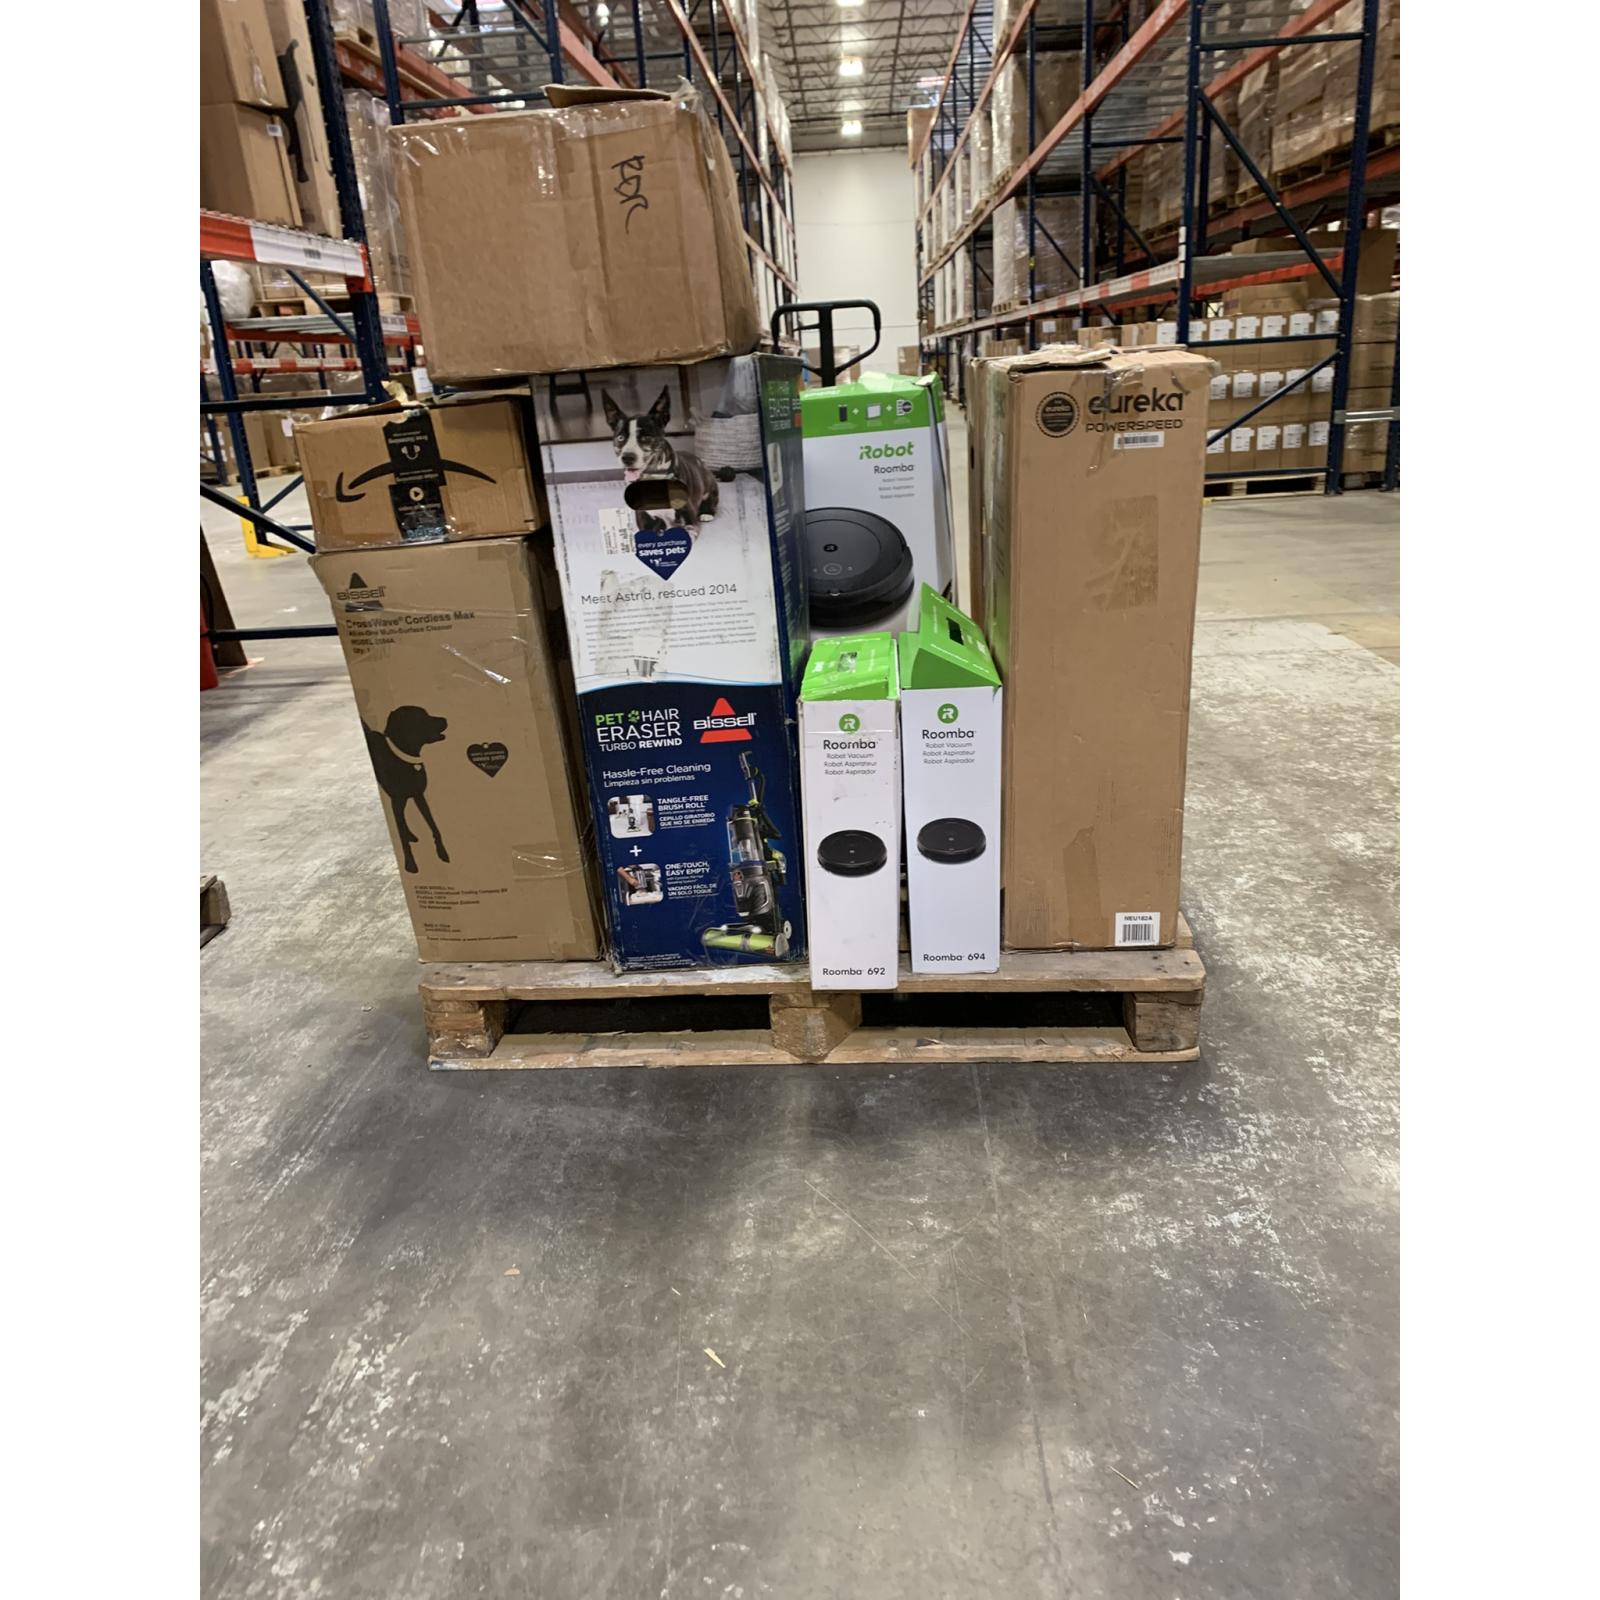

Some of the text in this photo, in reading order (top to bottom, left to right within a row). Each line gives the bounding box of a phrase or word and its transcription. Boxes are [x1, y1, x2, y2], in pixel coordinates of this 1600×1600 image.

[1088, 388, 1184, 414] eureka
[1086, 419, 1184, 432] POWERSPEED
[859, 442, 914, 460] iRobot
[874, 464, 914, 474] Roomba
[639, 546, 686, 556] saves pets
[581, 594, 612, 605] Meet
[658, 586, 705, 599] rescued
[709, 584, 737, 596] 2014
[405, 613, 450, 625] Cordless
[454, 611, 476, 620] Max
[596, 708, 680, 726] PET HAIR
[596, 721, 681, 743] ERASER
[922, 728, 975, 740] Roomba
[600, 738, 682, 752] TURBO REWIND
[823, 740, 877, 750] Roomba
[943, 750, 976, 758] Aspirateur
[844, 760, 877, 768] Aspirateur
[603, 763, 711, 780] Hassle-Free Cleaning
[604, 774, 696, 788] Limpieza sin problemas
[657, 794, 709, 804] TANGLE-FREE
[658, 804, 684, 812] BRUSH
[665, 861, 710, 870] ONE-TOUCH,
[923, 952, 986, 962] Roomba 694
[823, 967, 886, 976] Roomba 692
